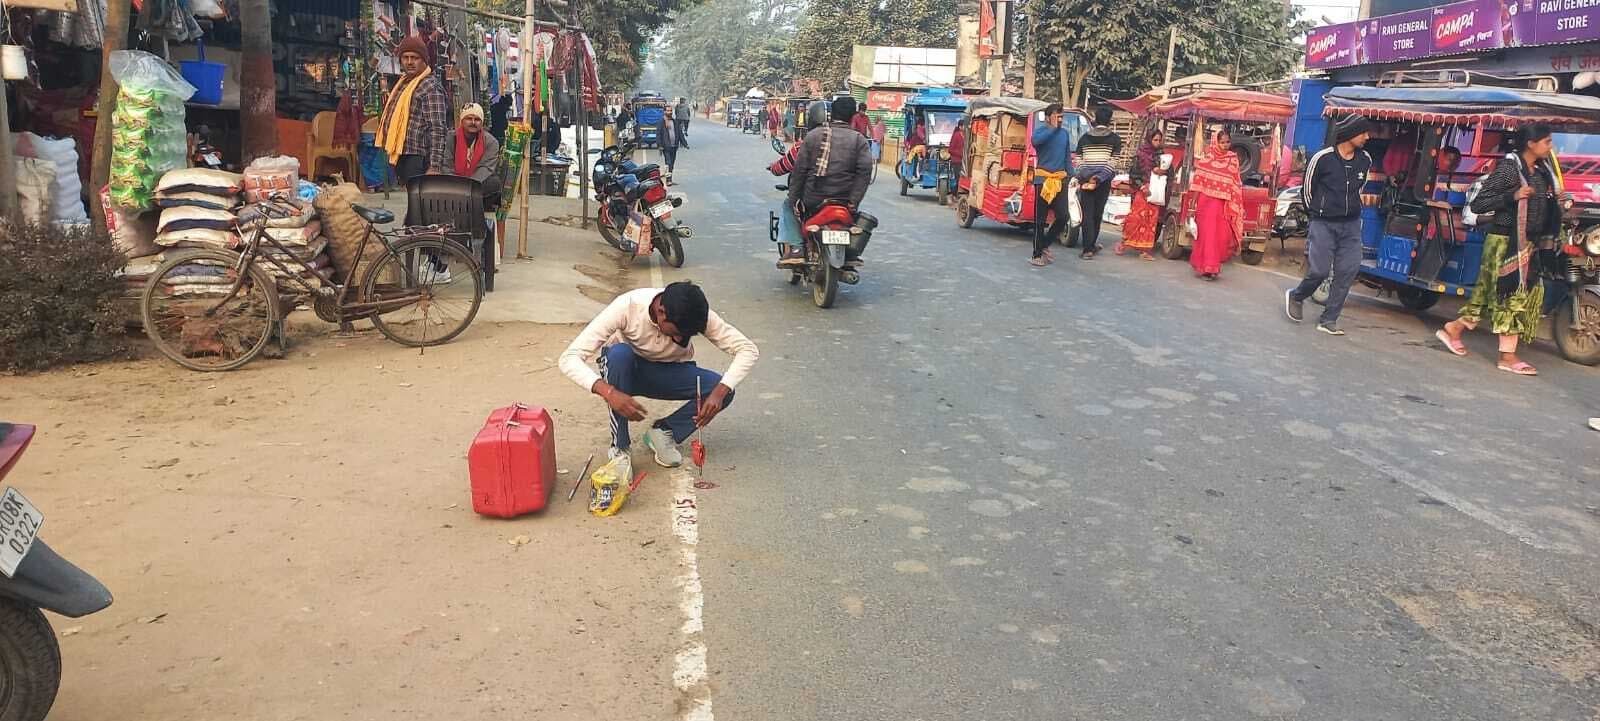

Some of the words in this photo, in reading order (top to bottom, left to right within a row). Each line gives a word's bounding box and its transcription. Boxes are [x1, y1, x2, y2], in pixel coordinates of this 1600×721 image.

[1540, 0, 1562, 14] RAVI
[1382, 25, 1397, 36] RAVI
[1398, 20, 1428, 34] GENERAL
[1436, 11, 1475, 39] CAMPA
[1557, 15, 1588, 30] STORE
[1309, 33, 1337, 55] CAMPA
[1393, 38, 1415, 51] STORE
[9, 512, 38, 555] 0322
